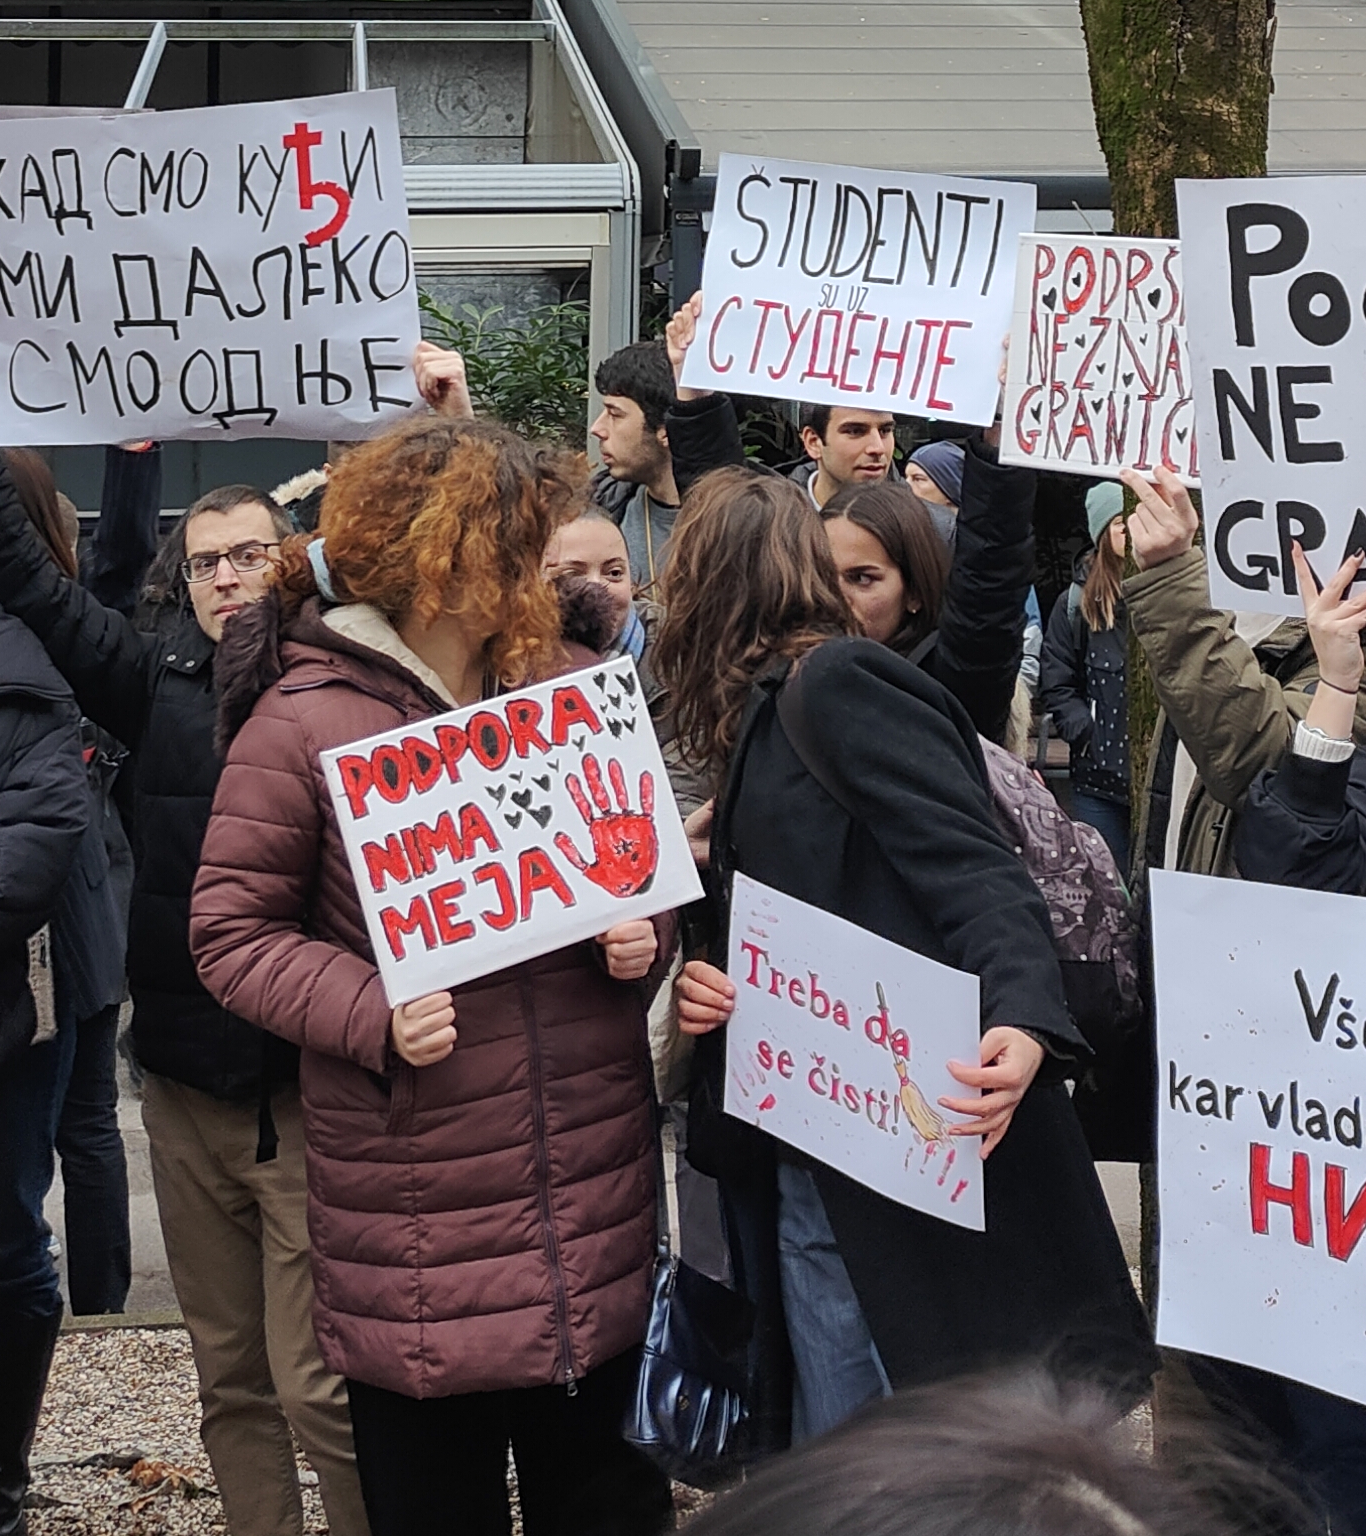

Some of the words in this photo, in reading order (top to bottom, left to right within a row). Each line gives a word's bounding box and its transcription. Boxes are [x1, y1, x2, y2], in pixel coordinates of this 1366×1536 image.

[104, 146, 208, 217] СМО
[730, 164, 1005, 297] ŠTUDENTI
[113, 230, 410, 341] ДАЛЕКО
[817, 283, 840, 309] SU
[847, 286, 869, 314] UZ
[1031, 244, 1185, 326] PODRŠ
[708, 295, 974, 412] СТУДЕНТЕ
[1212, 364, 1345, 464] NE
[336, 684, 604, 820] PODPORA
[361, 802, 505, 893] NIMA
[379, 846, 578, 963] MEJA
[740, 938, 852, 1032] Treba
[863, 1003, 912, 1062] da
[755, 1039, 796, 1080] se
[1167, 1059, 1244, 1122] kar
